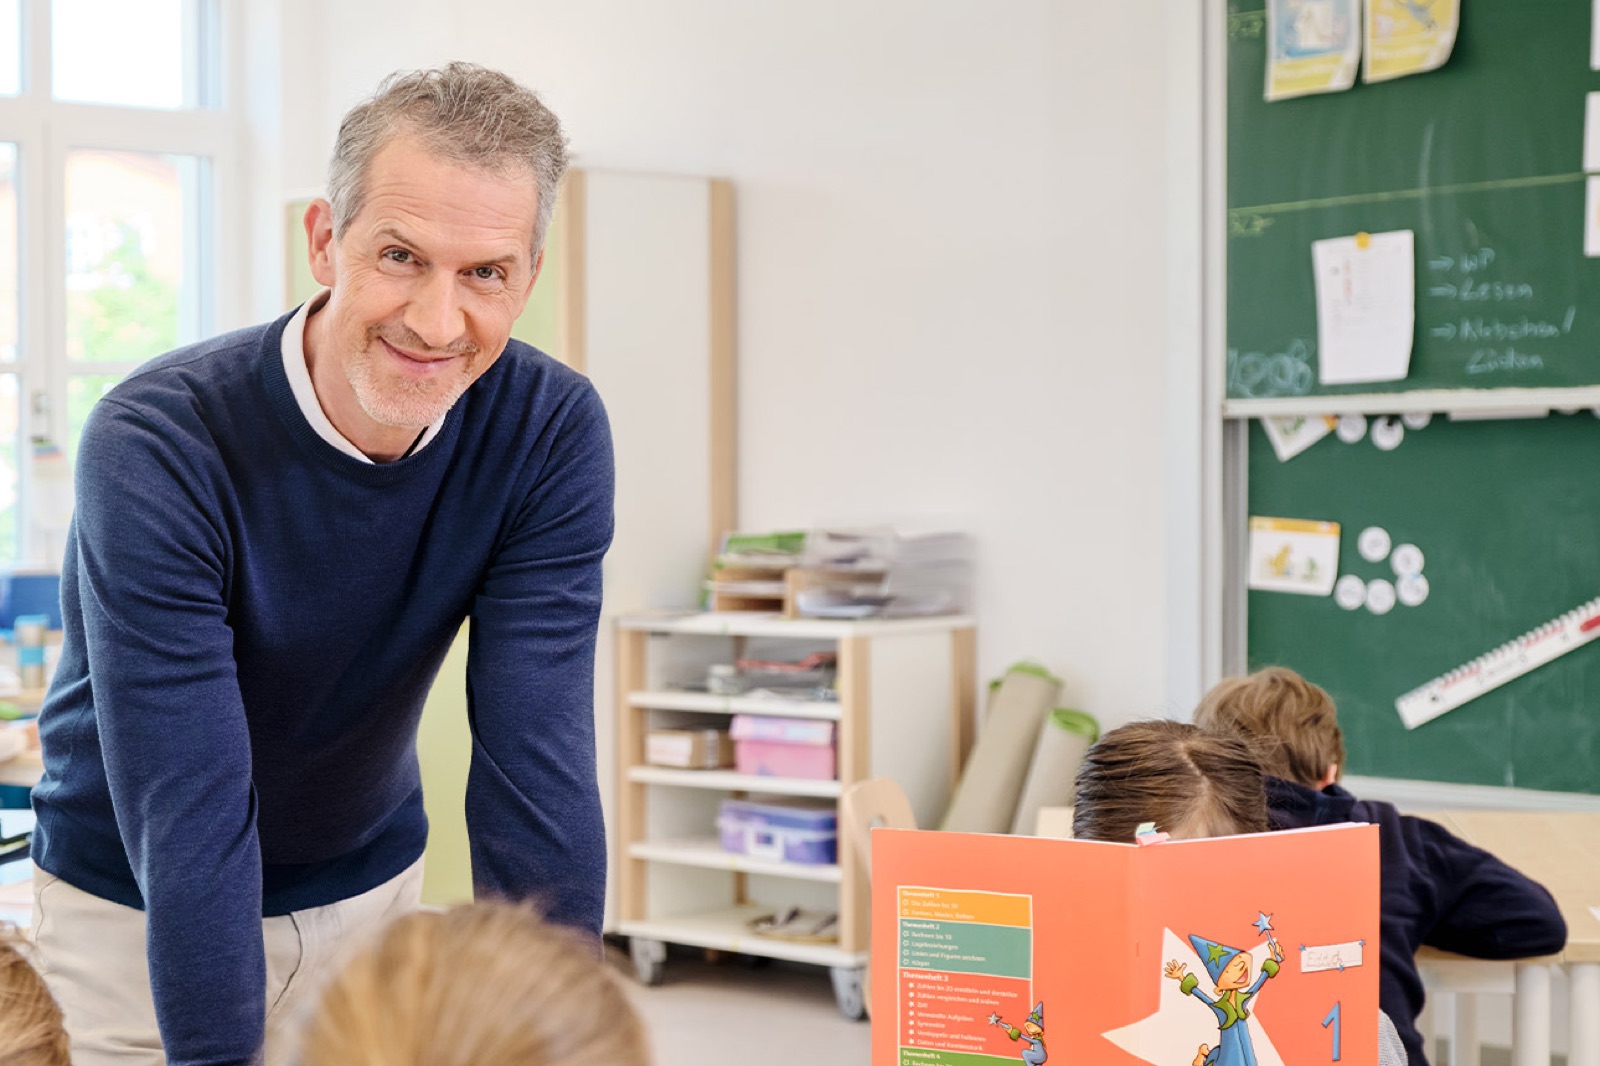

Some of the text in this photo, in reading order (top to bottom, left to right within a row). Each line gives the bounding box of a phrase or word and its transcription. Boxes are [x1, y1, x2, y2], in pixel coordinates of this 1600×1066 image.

[902, 921, 935, 930] Themenheft
[902, 972, 942, 981] Themenheft
[979, 987, 991, 995] und
[968, 996, 980, 1004] und
[1321, 1001, 1340, 1061] 1
[902, 1050, 936, 1059] Themenheft
